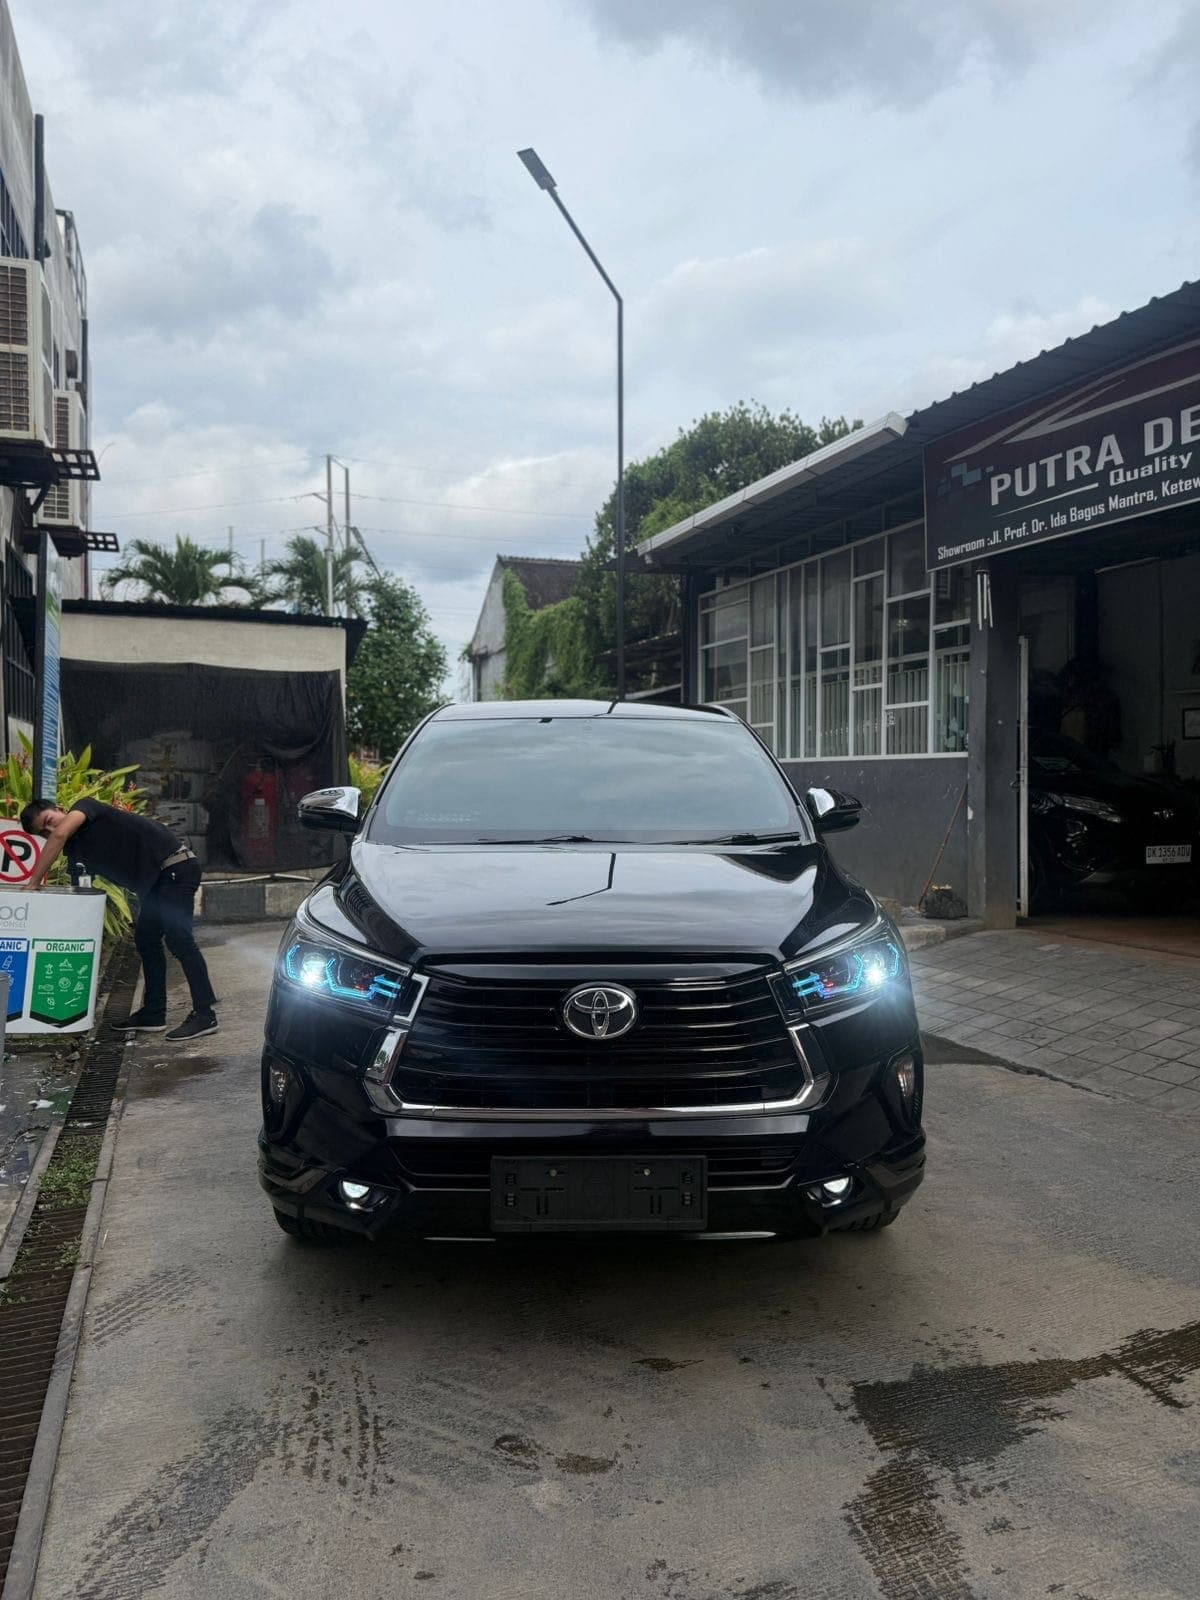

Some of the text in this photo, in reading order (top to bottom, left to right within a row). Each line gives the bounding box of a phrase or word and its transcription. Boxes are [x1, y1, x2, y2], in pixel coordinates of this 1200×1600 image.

[991, 434, 1124, 505] PUTRA
[1109, 452, 1193, 486] Quality
[938, 538, 985, 561] Showroom
[1004, 522, 1029, 541] Prof.
[1032, 518, 1048, 534] Dr.
[1051, 513, 1067, 529] Ida
[1070, 503, 1105, 522] Bagus
[1109, 489, 1158, 511] Mantra,
[45, 942, 86, 952] ORGANIC
